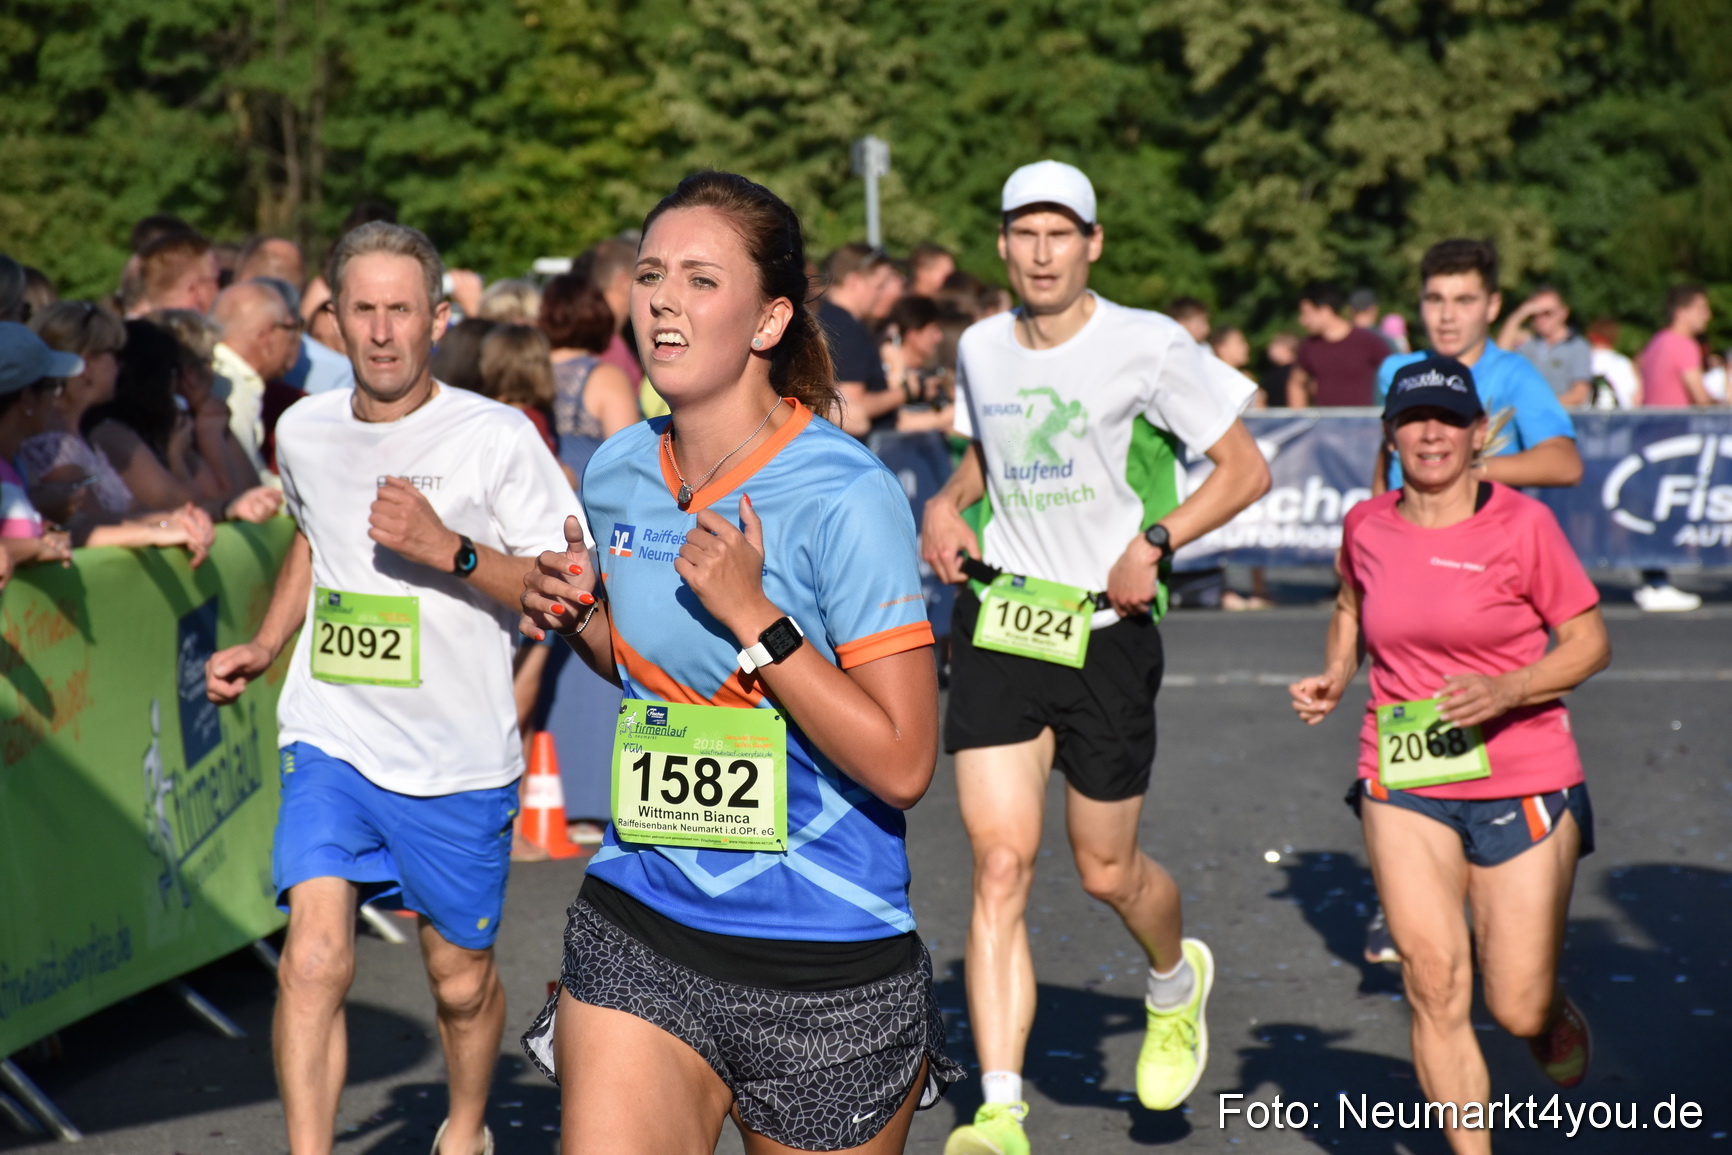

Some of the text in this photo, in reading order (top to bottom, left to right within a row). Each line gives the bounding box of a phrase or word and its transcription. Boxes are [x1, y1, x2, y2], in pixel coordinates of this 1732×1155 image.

[1003, 459, 1074, 485] Laufend
[1003, 484, 1096, 512] rfolgreich
[997, 601, 1074, 642] 1024
[320, 622, 401, 660] 2092
[635, 721, 688, 738] firmenlauf
[693, 738, 724, 751] 2018
[1389, 728, 1468, 764] 2068
[632, 752, 759, 808] 1582
[618, 818, 775, 836] Raiffeisenbank Neumarkt i.d.OPf. eG
[638, 805, 750, 824] Wittmann Bianca
